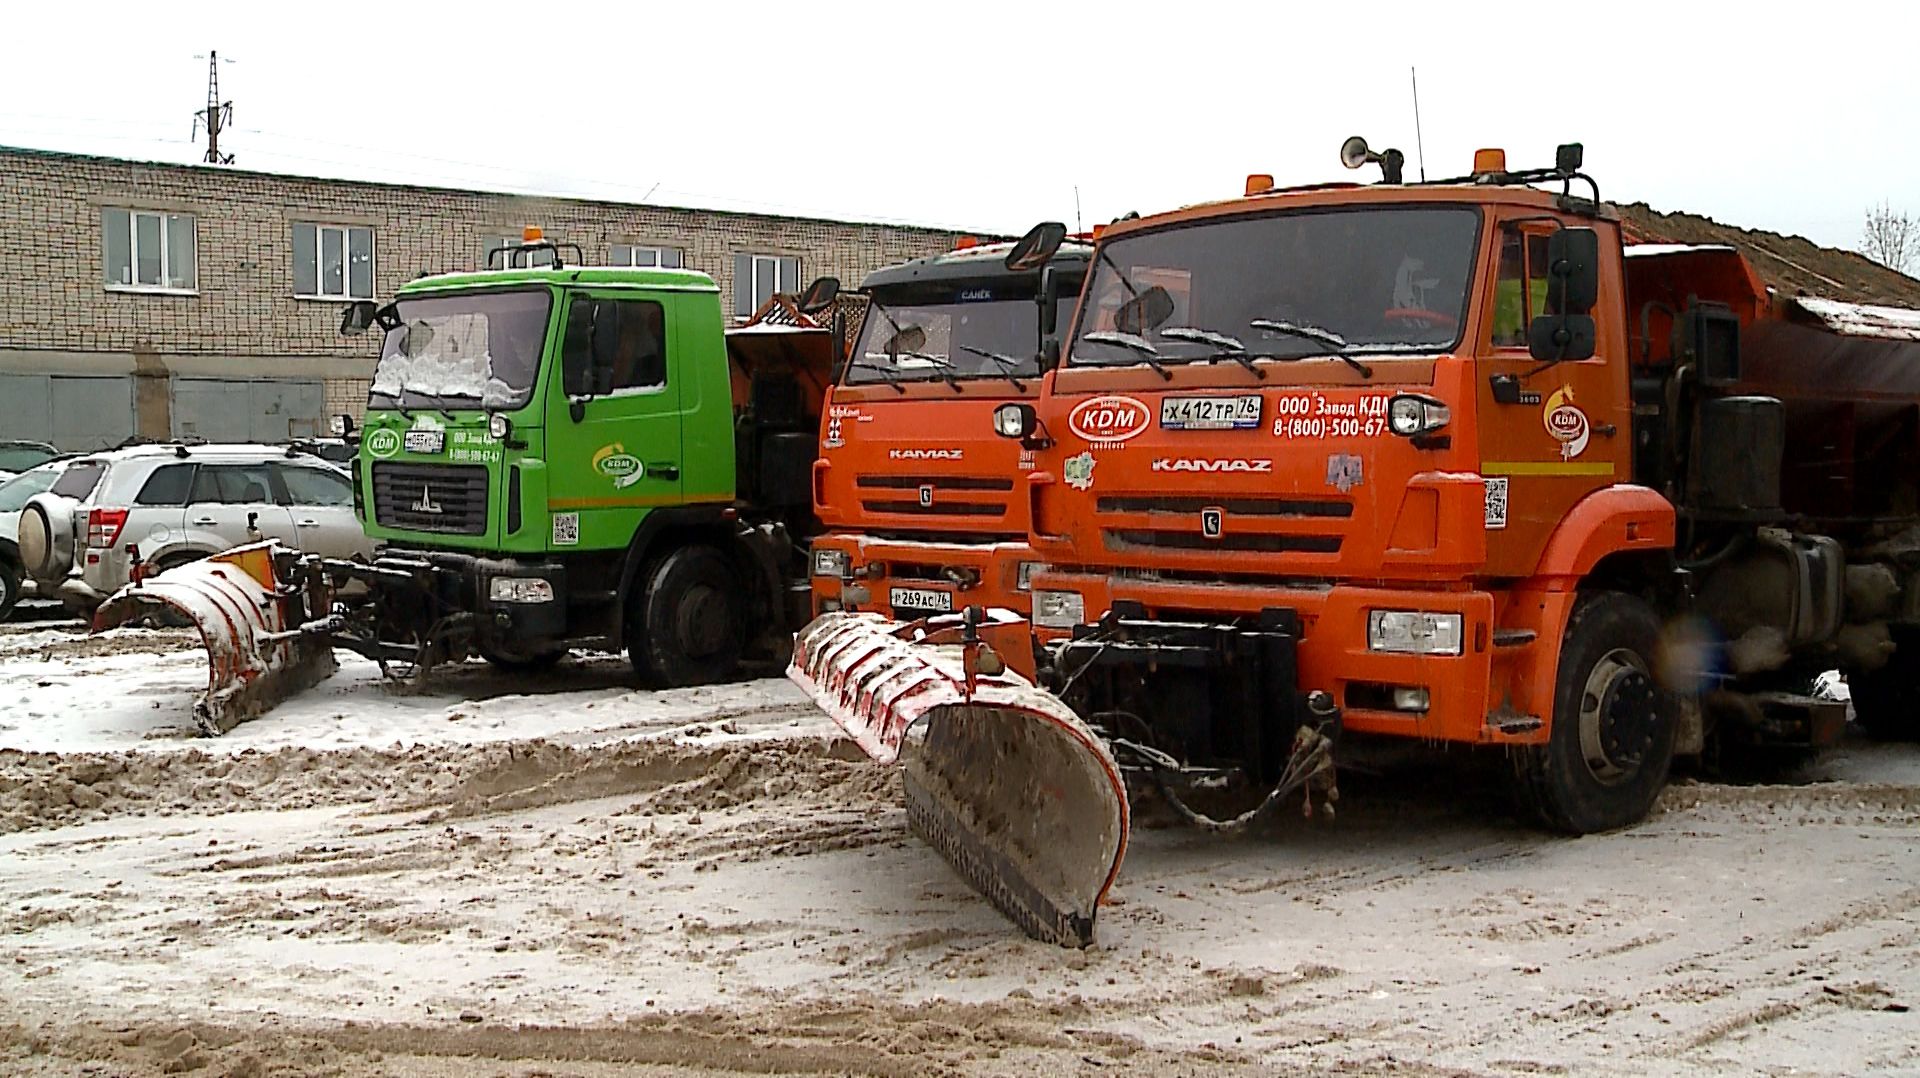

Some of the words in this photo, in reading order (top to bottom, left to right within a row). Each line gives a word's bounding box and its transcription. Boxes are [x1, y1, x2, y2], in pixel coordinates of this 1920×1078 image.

[1279, 396, 1310, 415] ООО
[1082, 409, 1136, 429] KDM
[1554, 413, 1577, 425] KDM
[1273, 418, 1390, 439] 8-(800)-500-67-
[371, 438, 394, 449] KDM
[890, 450, 963, 459] KAMAZ
[1152, 459, 1272, 472] KAMAZ
